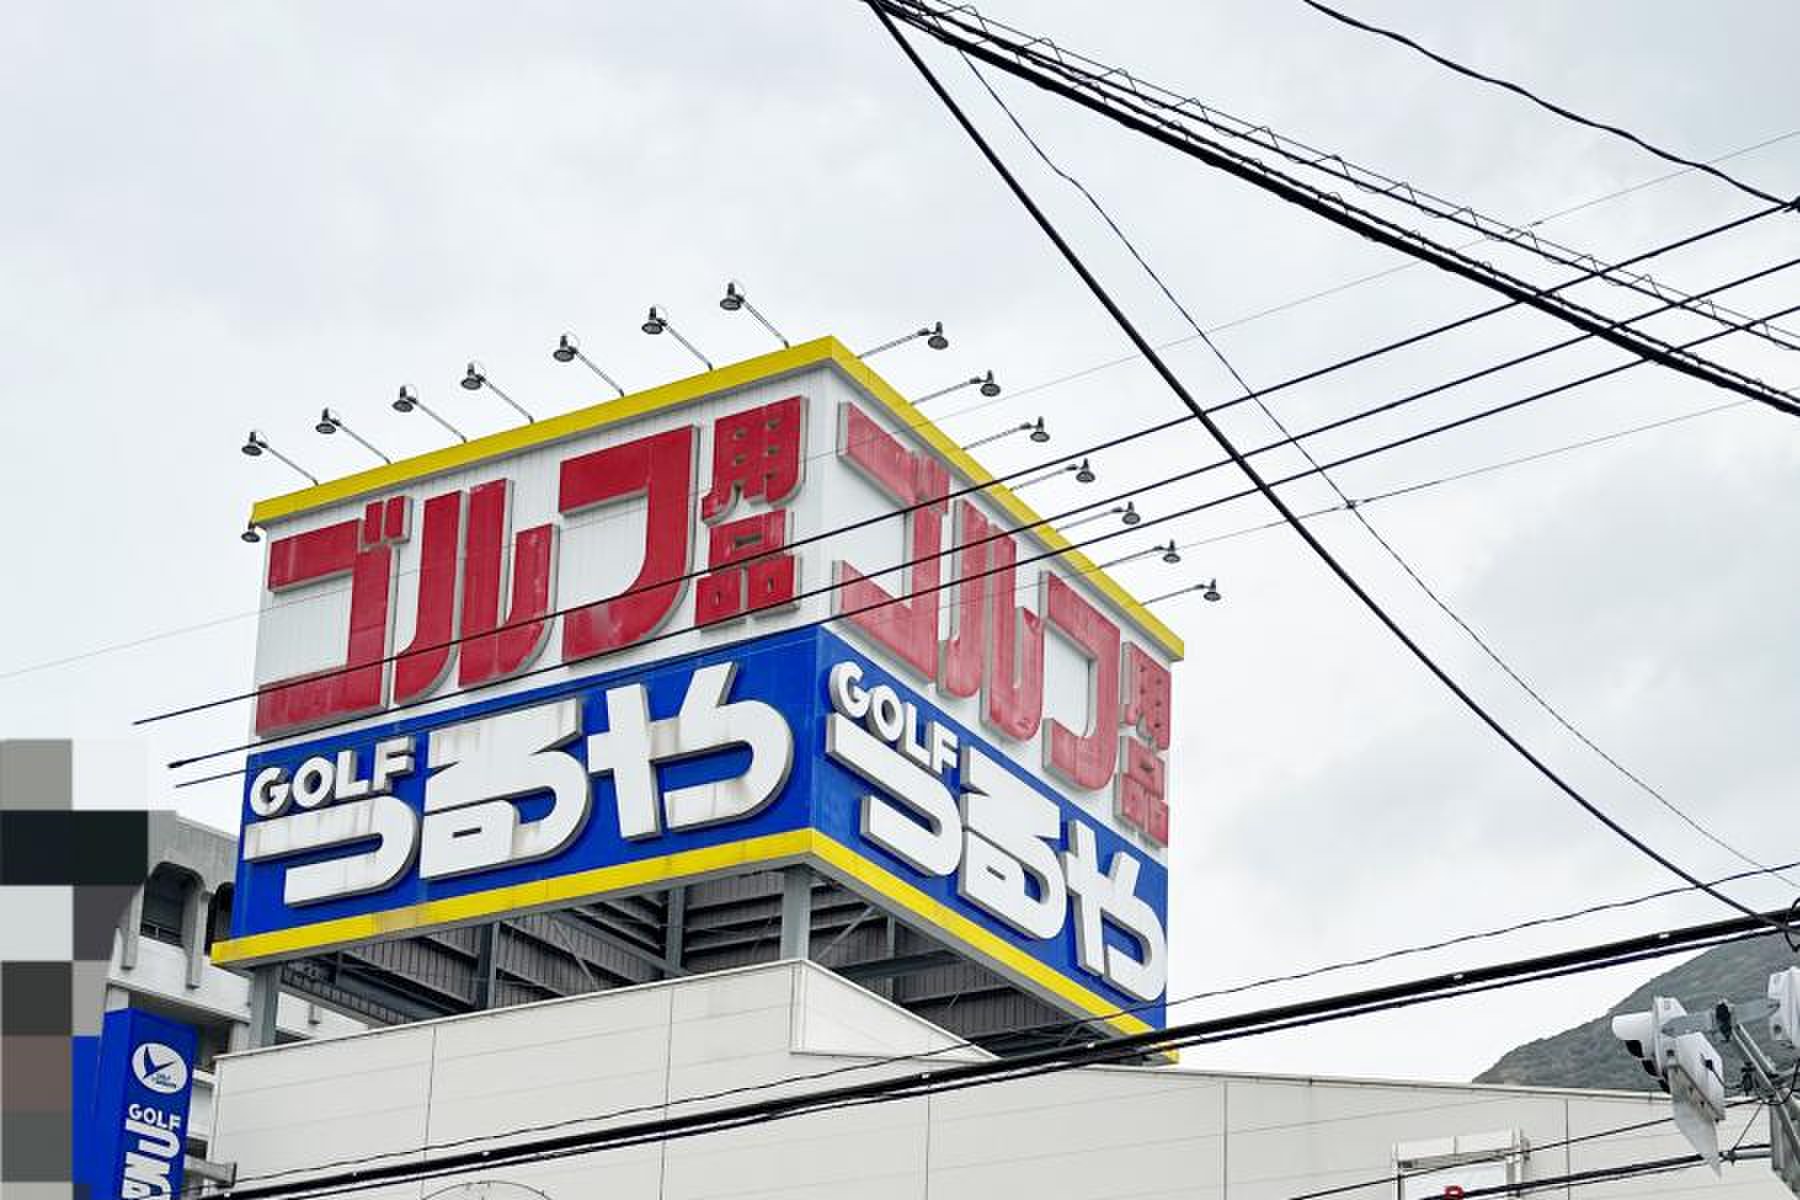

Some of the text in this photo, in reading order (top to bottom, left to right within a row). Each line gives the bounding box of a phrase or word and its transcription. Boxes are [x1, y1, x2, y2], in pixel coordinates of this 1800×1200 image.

[829, 661, 958, 774] GOLF
[244, 661, 794, 906] つるや
[249, 734, 413, 818] GOLF
[826, 713, 1167, 1002] つるや
[128, 1103, 181, 1130] GOLF
